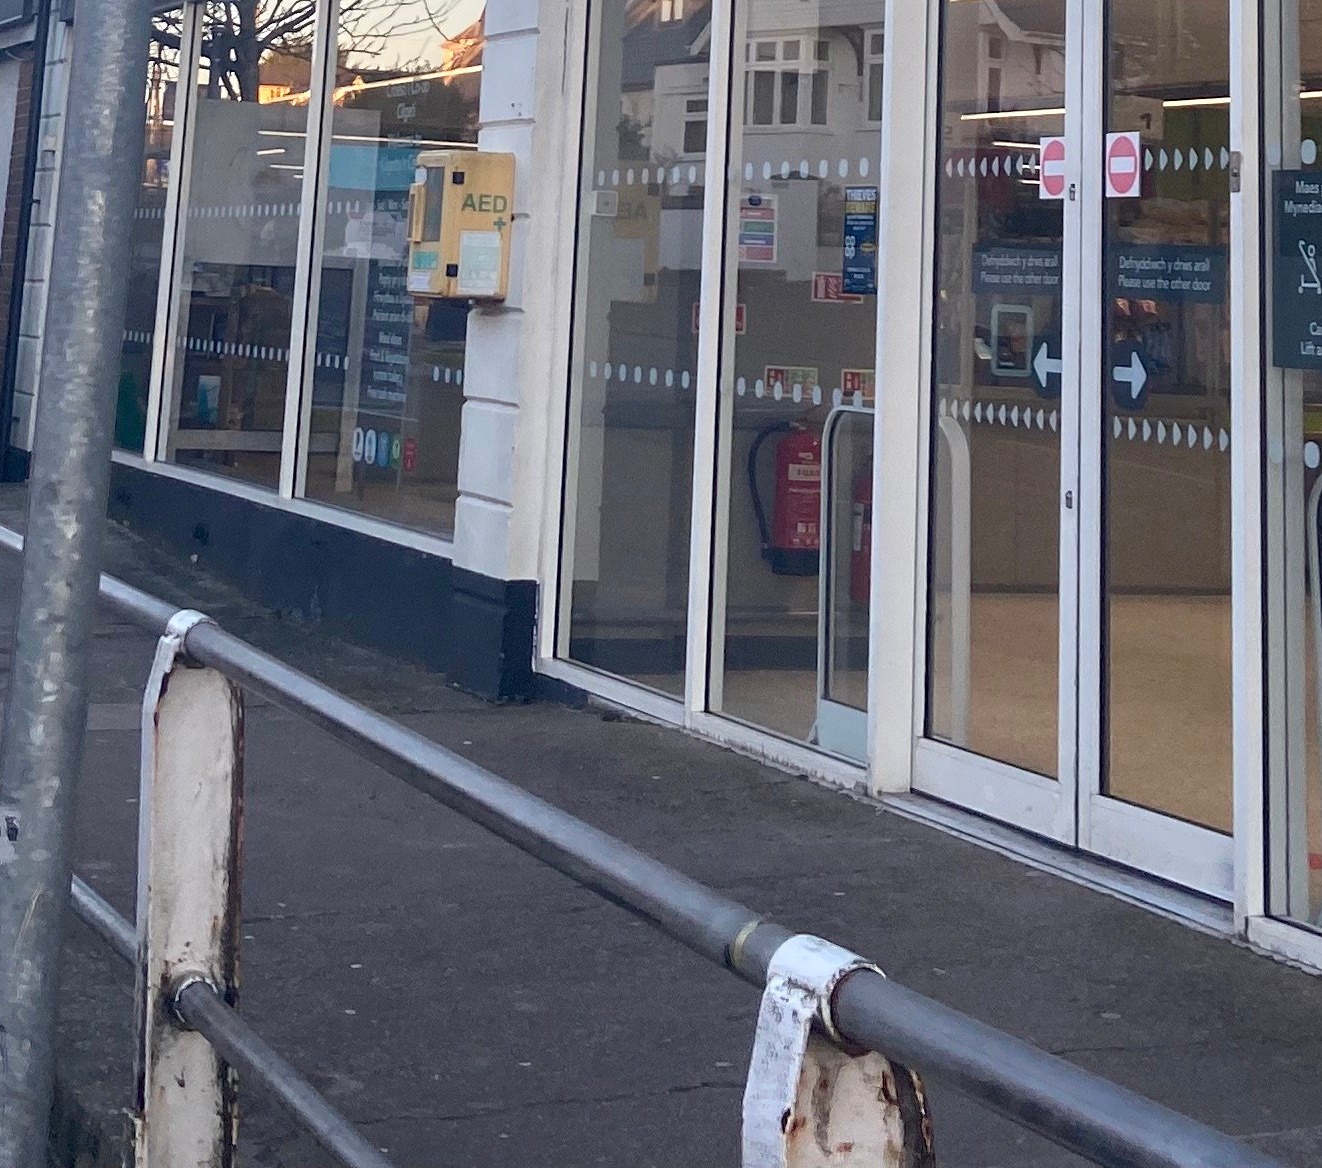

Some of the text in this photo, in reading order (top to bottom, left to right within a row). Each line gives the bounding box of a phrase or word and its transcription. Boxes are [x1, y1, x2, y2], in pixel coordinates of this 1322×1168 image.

[1140, 113, 1152, 131] 1
[1295, 180, 1319, 194] Maes
[461, 193, 507, 214] AED
[1174, 257, 1193, 271] drws
[981, 271, 1059, 286] Please use the other door
[1119, 274, 1211, 292] Please use the other door
[1300, 340, 1316, 355] Lift
